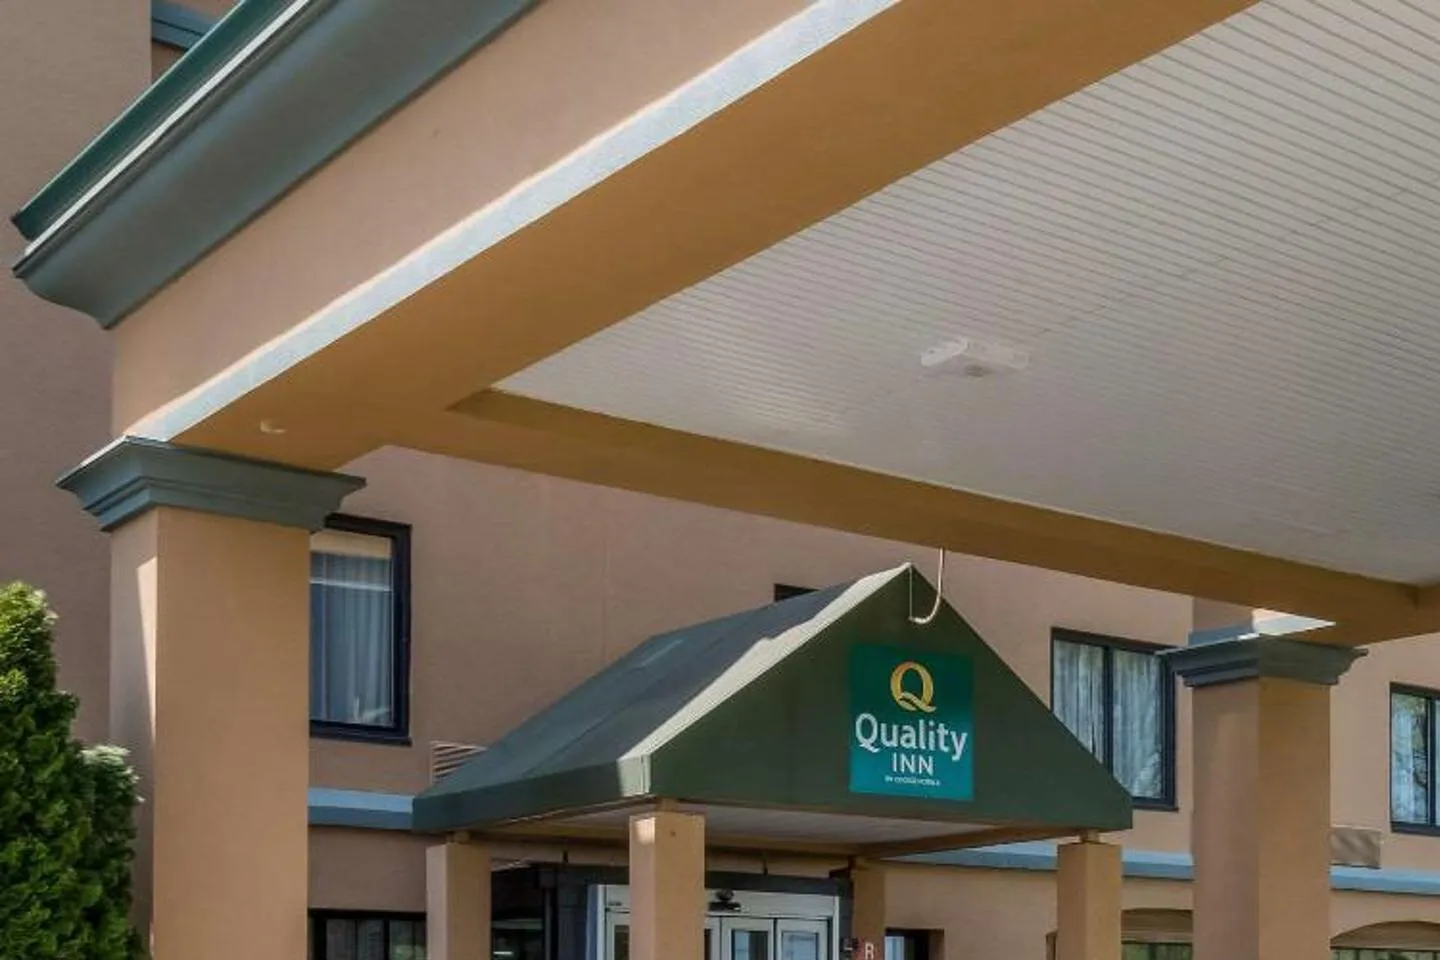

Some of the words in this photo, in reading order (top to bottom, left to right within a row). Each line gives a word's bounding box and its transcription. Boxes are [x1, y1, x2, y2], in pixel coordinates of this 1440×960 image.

[890, 660, 937, 713] Q
[855, 712, 968, 762] Quality
[892, 751, 934, 776] INN
[865, 942, 875, 960] R
